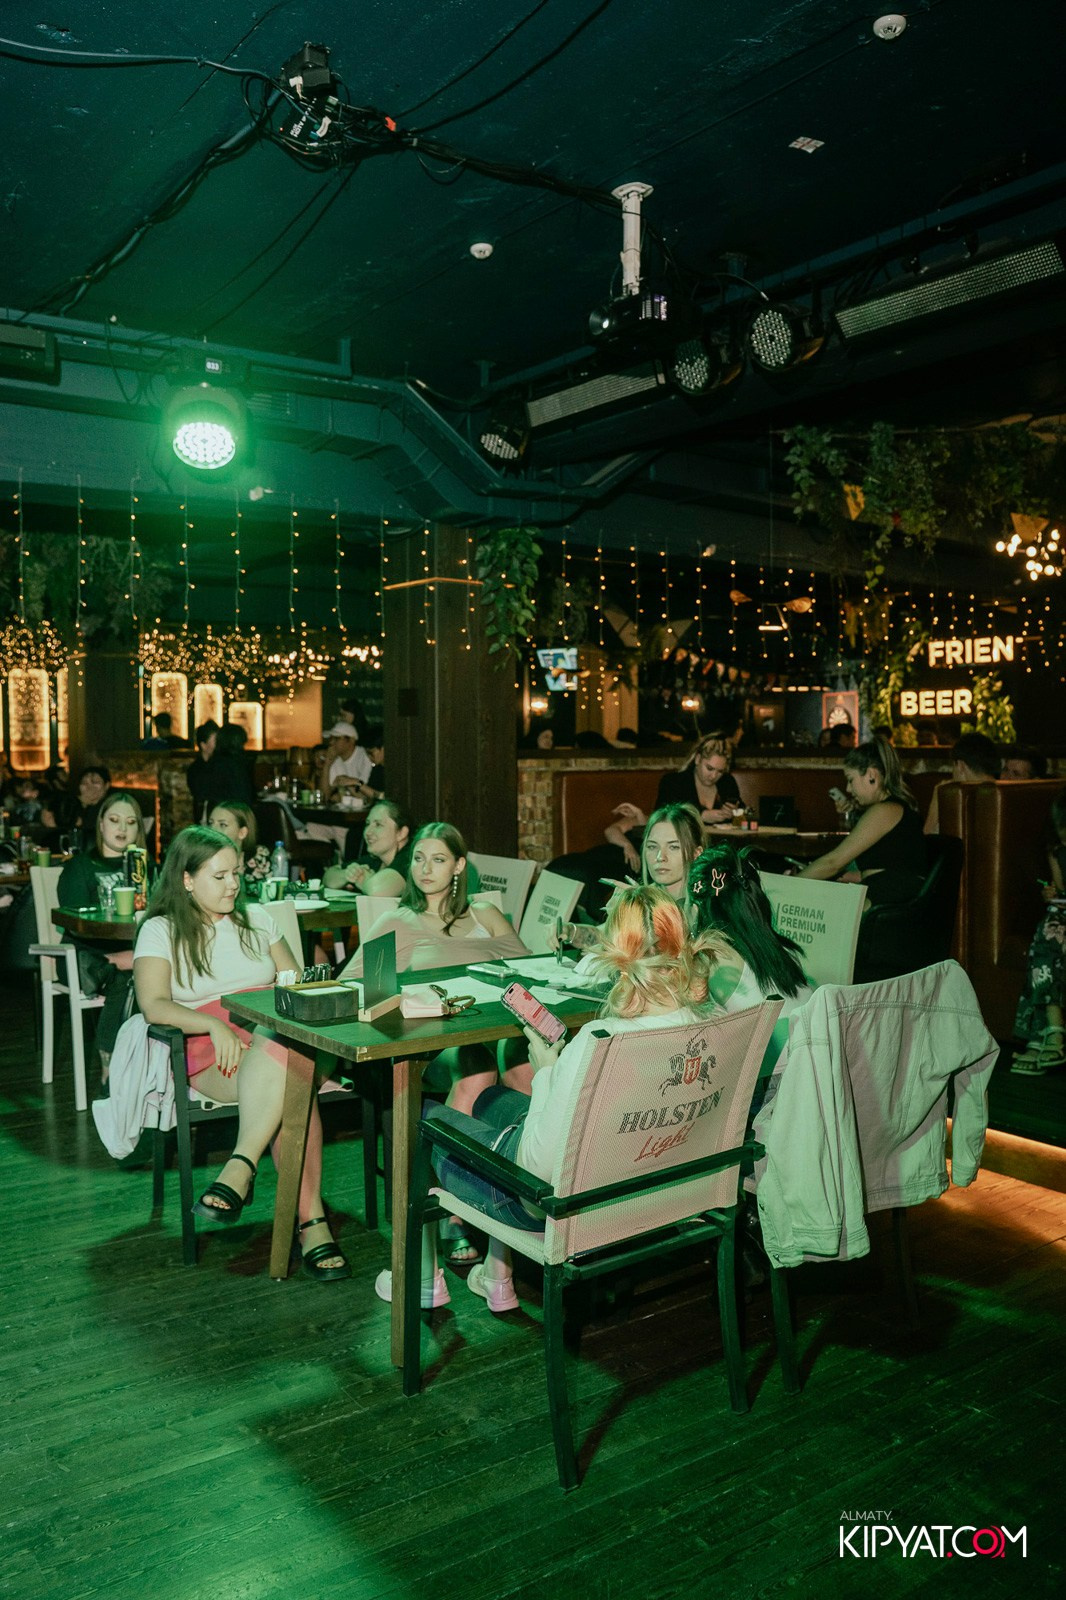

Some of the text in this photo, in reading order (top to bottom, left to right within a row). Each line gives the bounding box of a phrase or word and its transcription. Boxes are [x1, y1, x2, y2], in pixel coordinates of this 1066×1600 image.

[928, 635, 1014, 667] FRIEN
[900, 688, 973, 716] BEER
[780, 916, 826, 934] PREMIUM
[781, 903, 825, 920] GERMAN
[617, 1086, 726, 1134] HOLSTEN
[634, 1122, 696, 1162] Light
